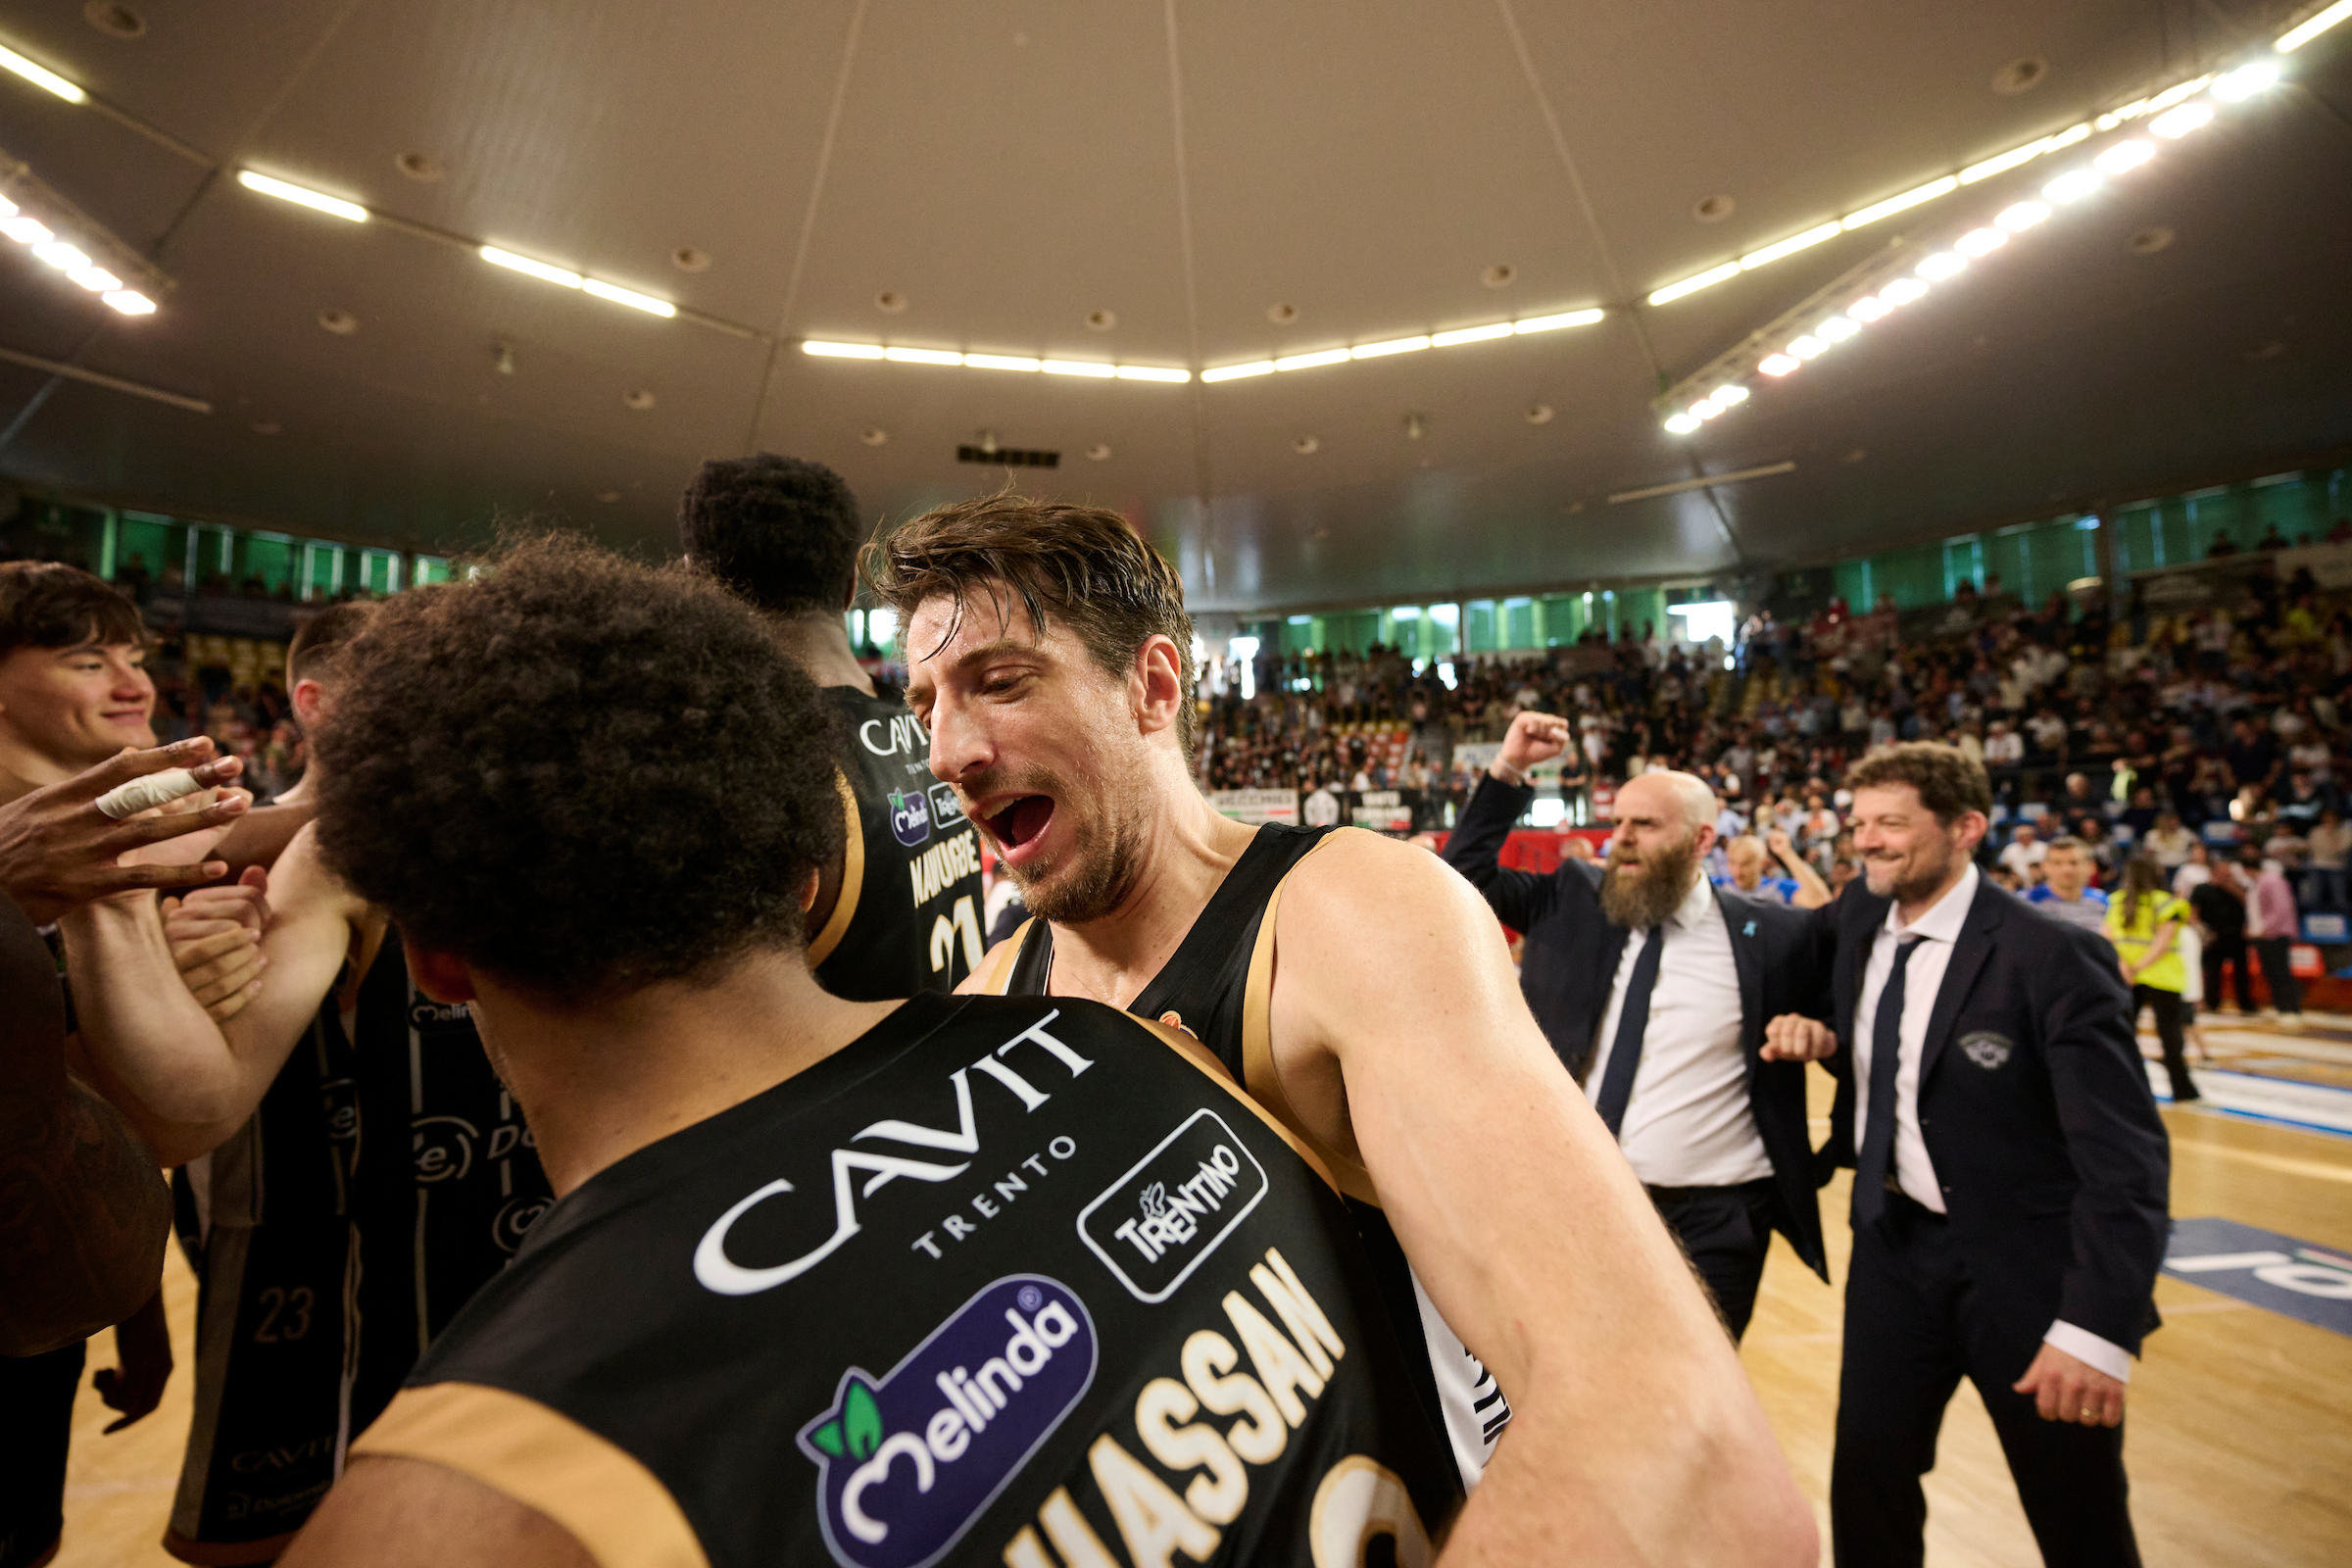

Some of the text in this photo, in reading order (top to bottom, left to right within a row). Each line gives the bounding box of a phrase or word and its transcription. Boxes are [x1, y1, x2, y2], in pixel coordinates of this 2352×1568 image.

[859, 714, 929, 756] CAVI
[412, 1004, 469, 1022] Melin
[693, 1008, 1095, 1296] CAVIT
[911, 1135, 1077, 1260] TRENTO
[1115, 1144, 1240, 1264] TRENTINO
[254, 1286, 315, 1344] 23
[841, 1298, 1079, 1544] Melinda
